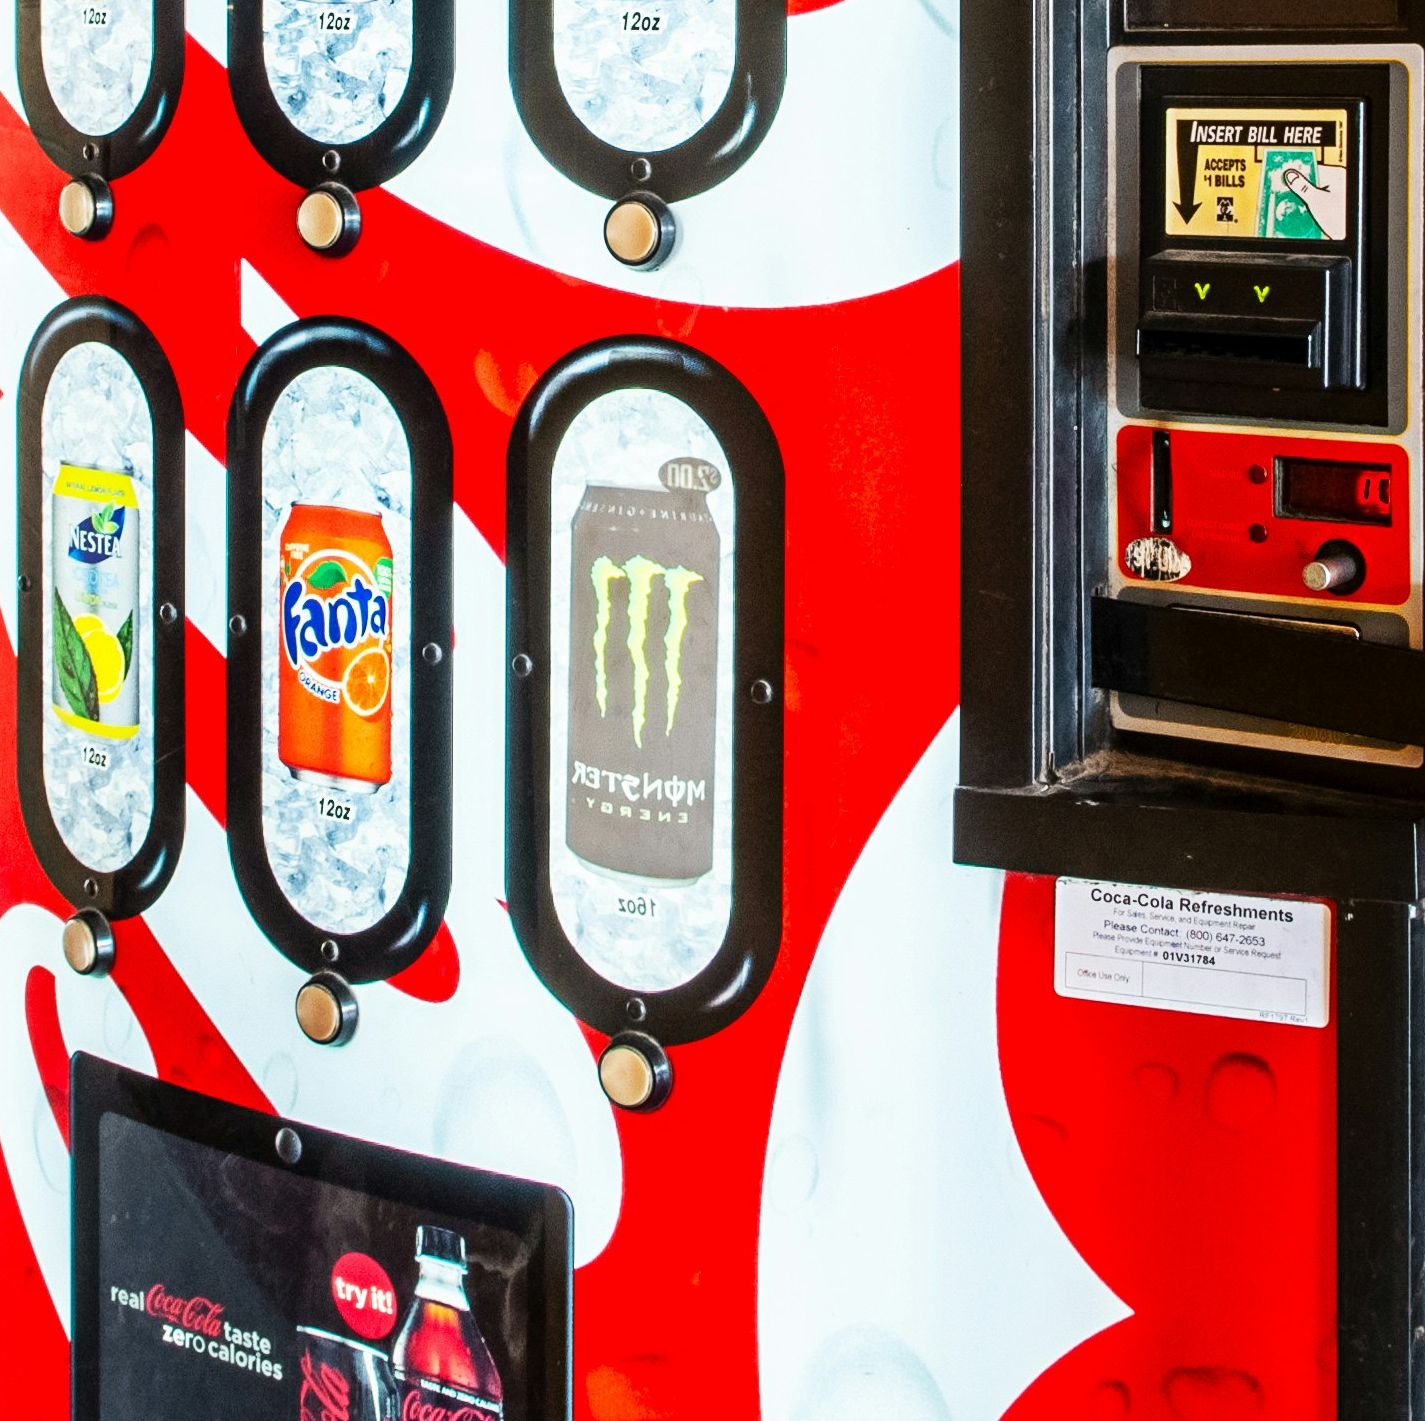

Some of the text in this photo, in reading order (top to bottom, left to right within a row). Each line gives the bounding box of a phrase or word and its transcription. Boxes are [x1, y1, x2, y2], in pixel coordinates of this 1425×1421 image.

[83, 8, 106, 26] 12oz
[319, 13, 350, 31] 12oz
[622, 11, 660, 31] 12oz
[1190, 120, 1243, 143] INSERT
[1247, 126, 1277, 143] BILL
[1283, 126, 1322, 144] HERE
[1204, 158, 1246, 172] ACCEPTS
[1214, 174, 1245, 188] BILLS
[70, 524, 123, 557] NESTEA
[299, 671, 338, 701] ORANGE
[83, 746, 106, 767] 12oz
[319, 798, 351, 820] 12oz
[1091, 888, 1294, 923] Coca-Cola Refreshments
[1113, 908, 1125, 916] For
[1178, 915, 1192, 924] and
[1194, 917, 1231, 929] Equipment
[1233, 921, 1255, 932] Repair
[1093, 931, 1115, 941] Please
[1117, 933, 1143, 944] Provide
[1145, 937, 1182, 949] Equipment
[1184, 942, 1212, 952] Number
[1223, 946, 1249, 956] Service
[1251, 949, 1281, 960] Request
[1104, 920, 1137, 933] Please
[1186, 929, 1213, 942] (800)
[1216, 933, 1266, 947] 647-2653
[1115, 945, 1151, 957] Equipment
[1162, 951, 1216, 966] 01V31784
[1077, 969, 1130, 984] Office Use Only
[335, 1277, 393, 1315] try it!
[111, 1284, 271, 1355] real Coca-Cola taste
[163, 1324, 283, 1380] zero calories
